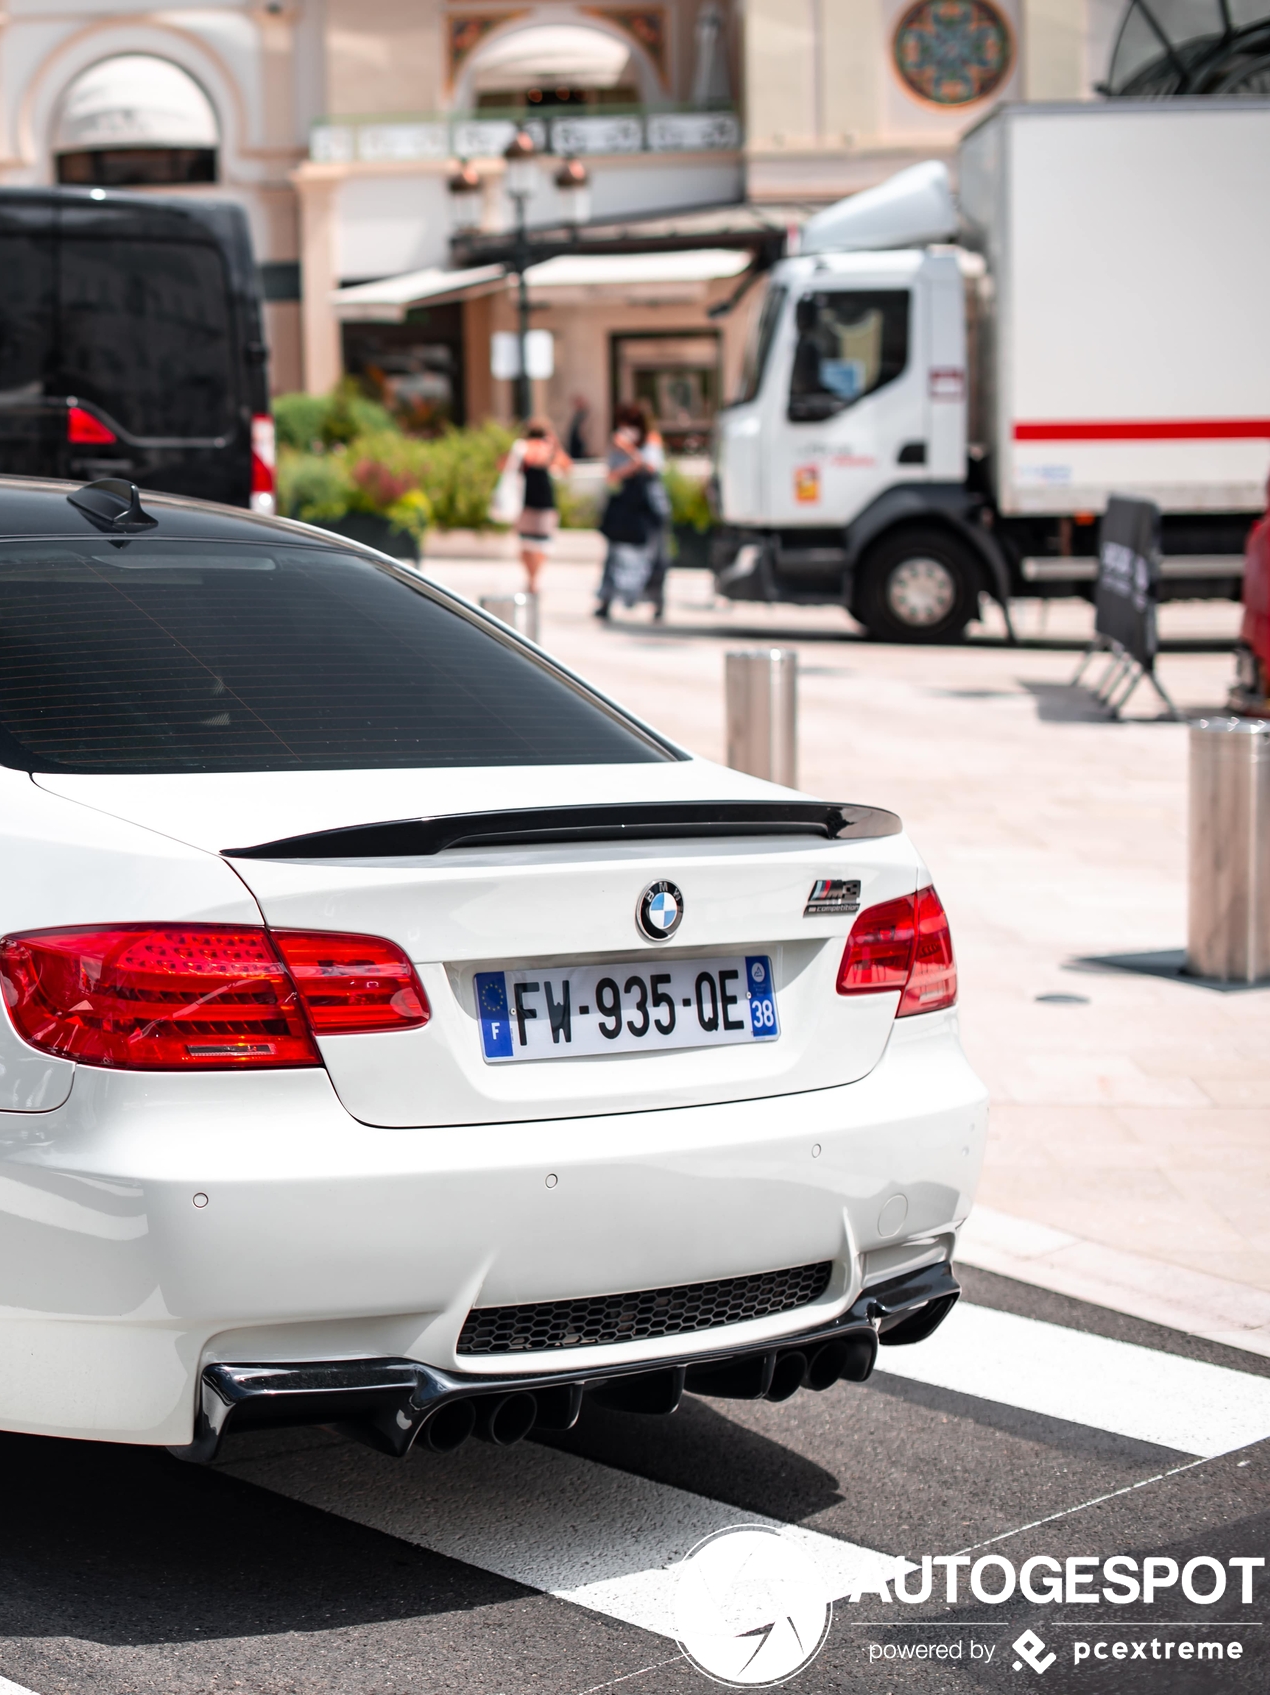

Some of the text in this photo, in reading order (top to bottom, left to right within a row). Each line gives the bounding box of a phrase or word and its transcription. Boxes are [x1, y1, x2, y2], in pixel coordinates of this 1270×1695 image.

[816, 904, 859, 912] competition
[514, 970, 745, 1046] FW-935-QE
[751, 999, 775, 1028] 38
[491, 1022, 501, 1040] F
